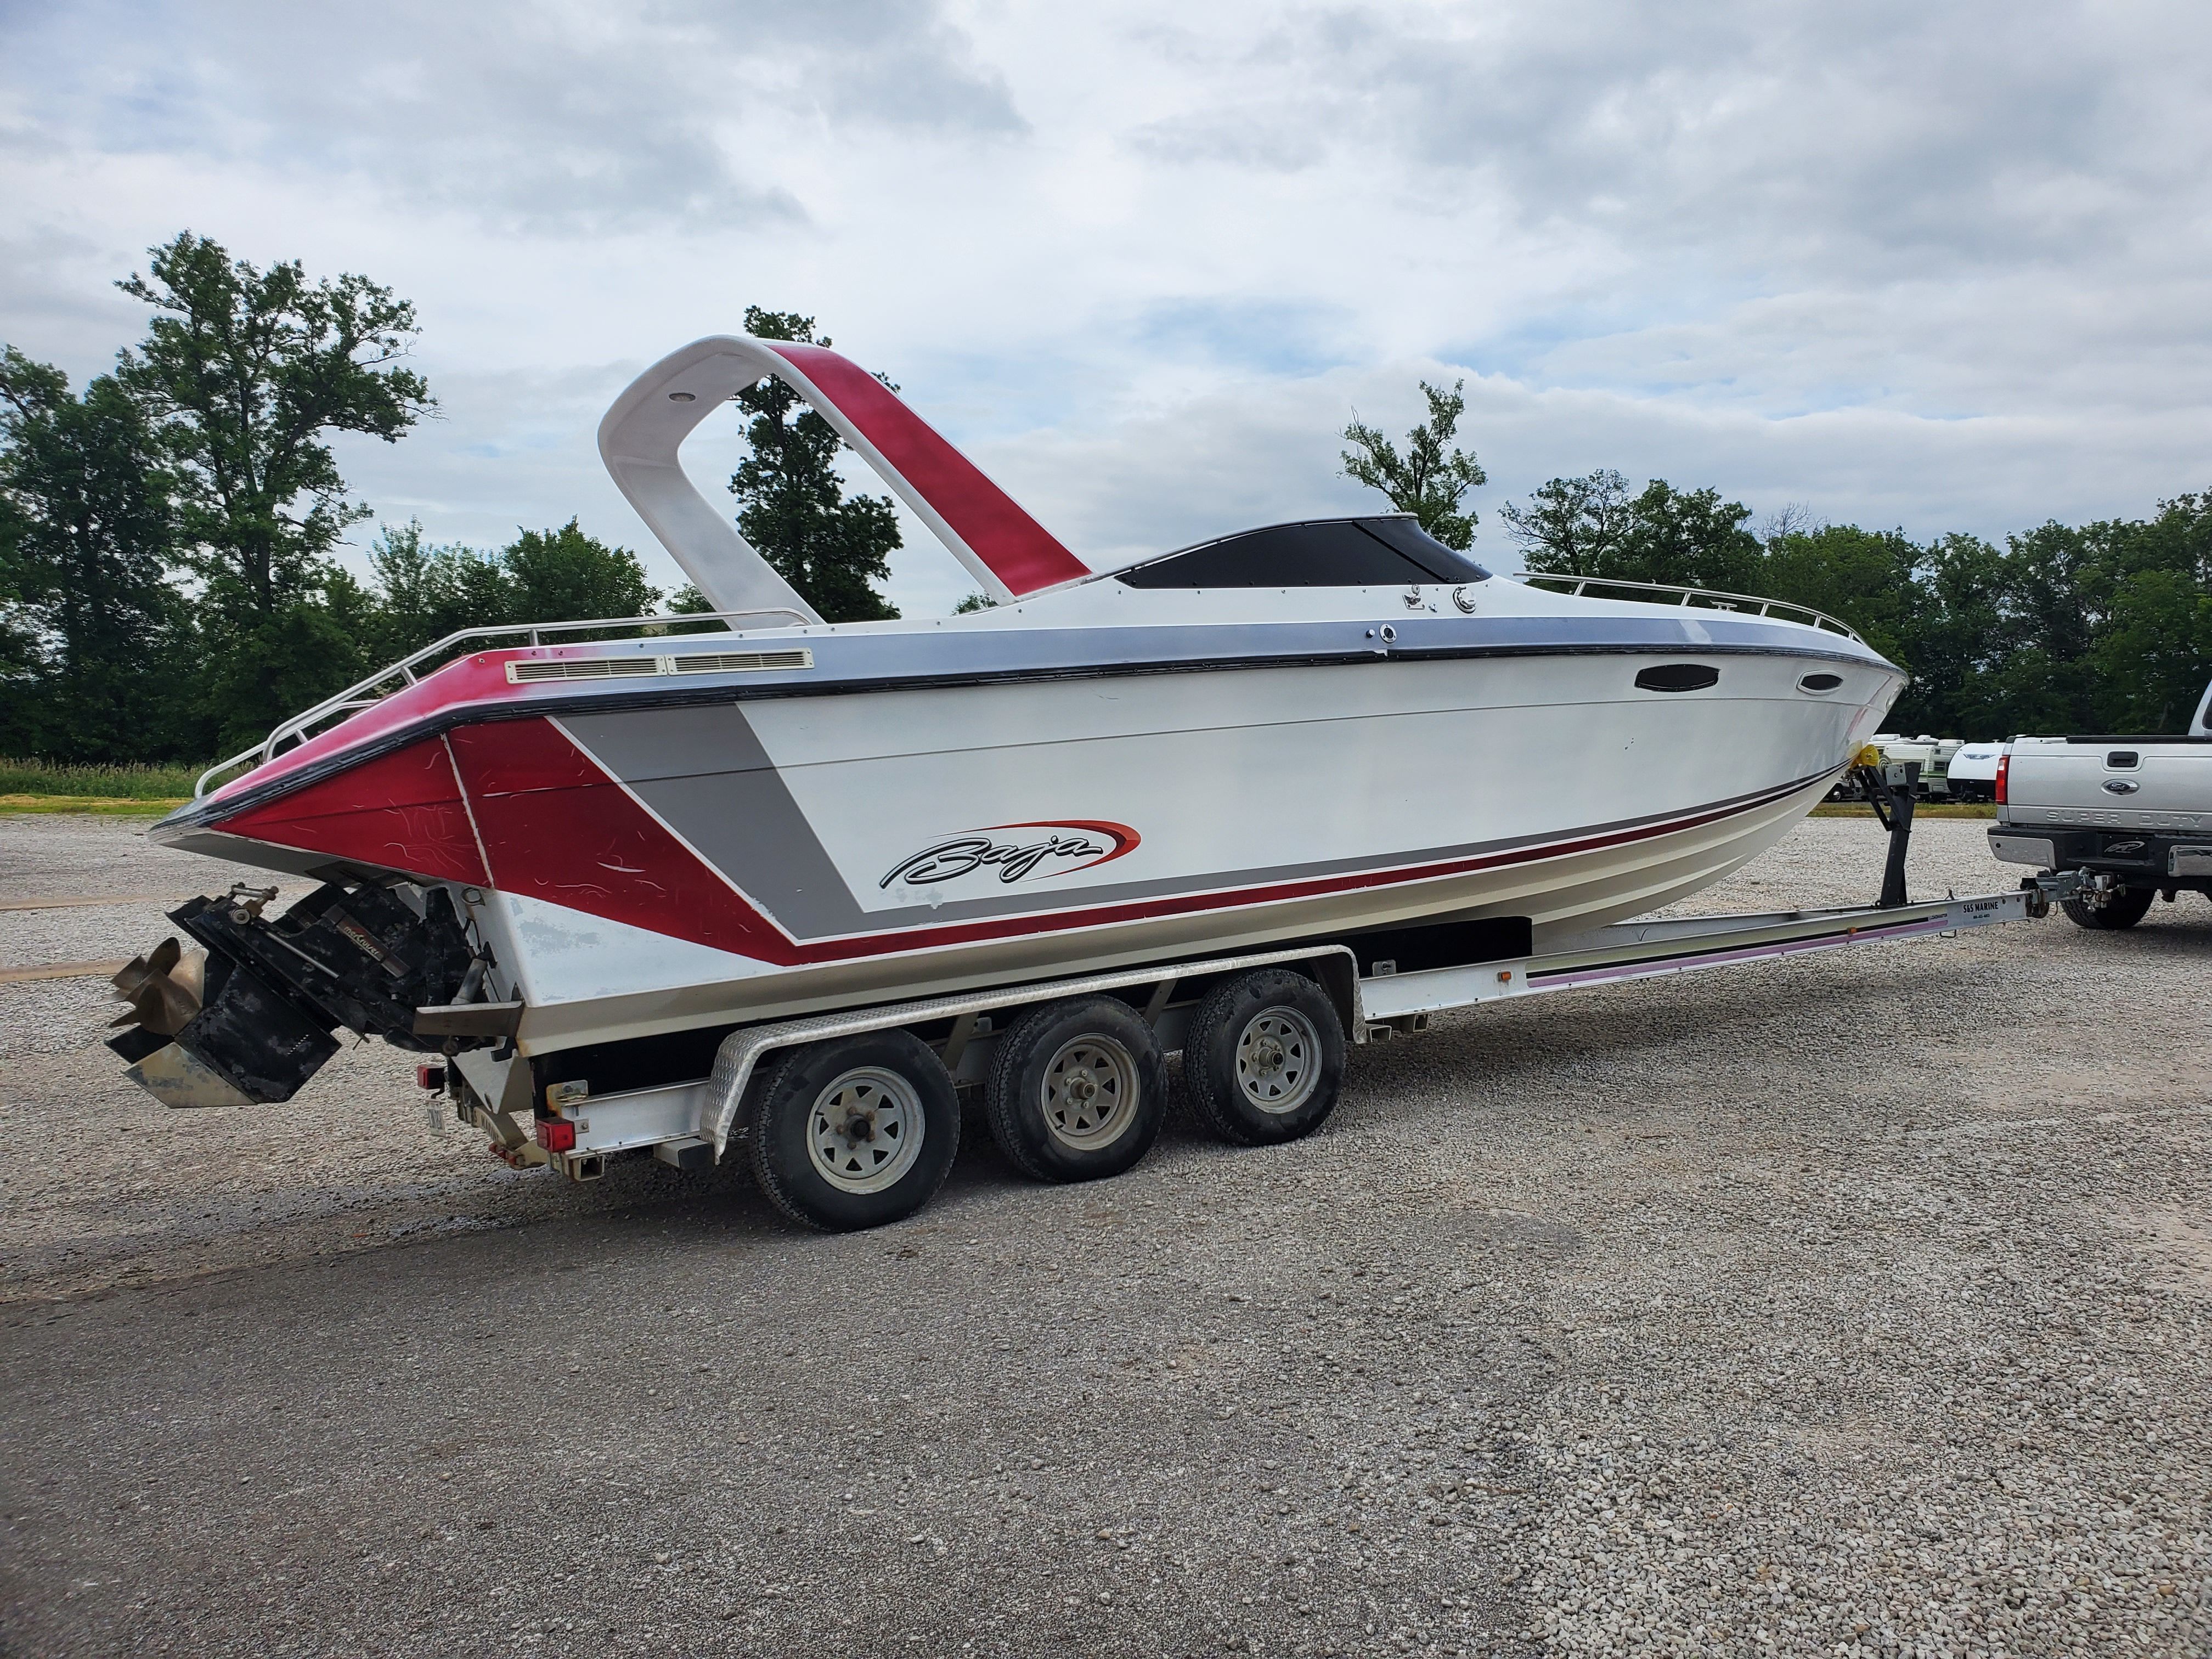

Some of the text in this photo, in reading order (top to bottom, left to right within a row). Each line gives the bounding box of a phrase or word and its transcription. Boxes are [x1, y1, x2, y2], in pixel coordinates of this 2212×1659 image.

[2047, 810, 2203, 827] SUPER DUTY
[879, 835, 1104, 889] Baja
[1963, 901, 1999, 913] S&S MARINE
